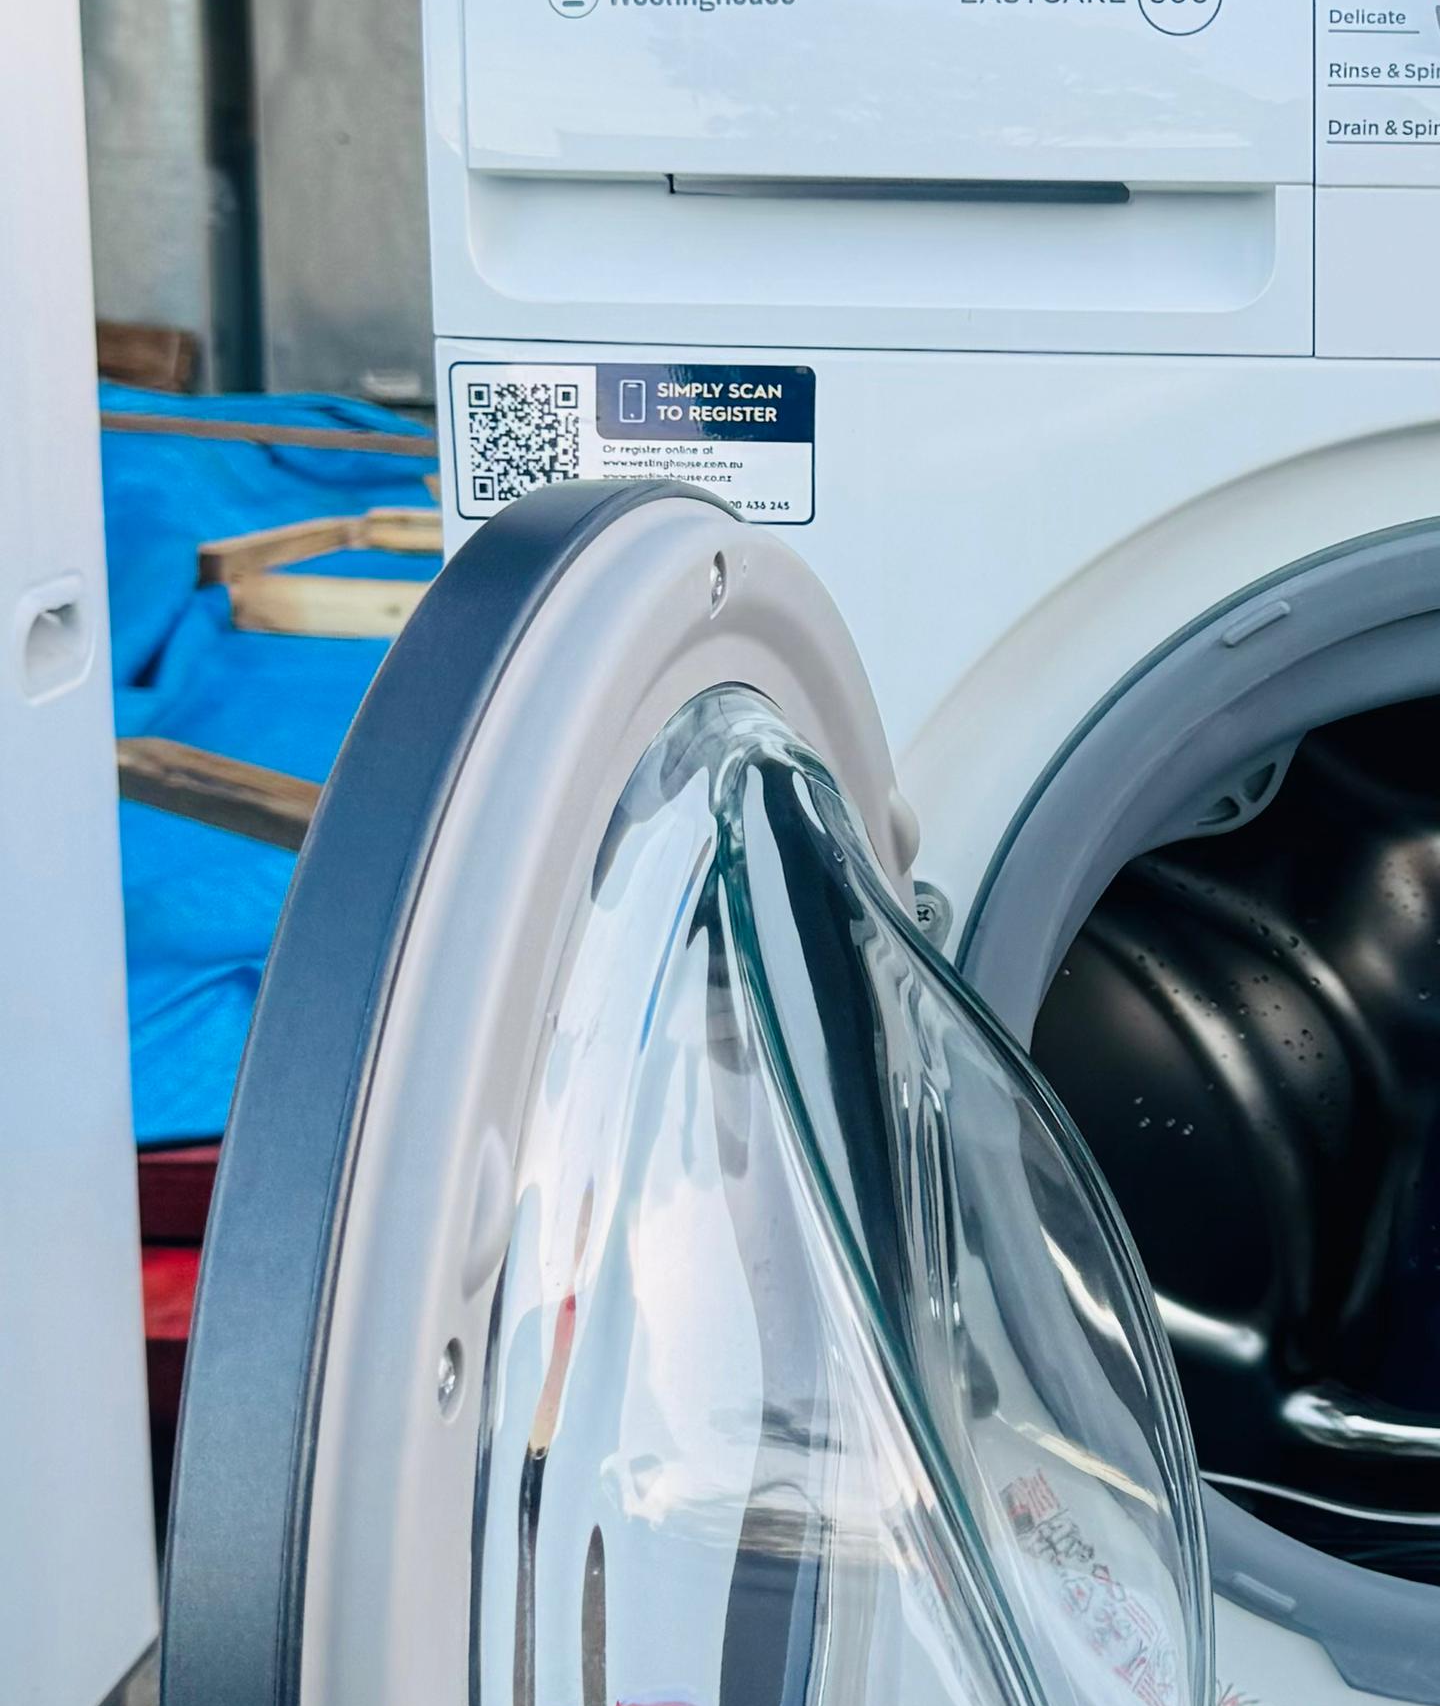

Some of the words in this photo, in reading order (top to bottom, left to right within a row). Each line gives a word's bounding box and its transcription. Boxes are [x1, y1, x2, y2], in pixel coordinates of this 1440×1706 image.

[1329, 9, 1407, 24] Delicate
[1329, 62, 1382, 79] Rinse
[1386, 63, 1400, 79] &
[1328, 119, 1379, 135] Drain
[1384, 120, 1398, 136] &
[657, 382, 724, 398] SIMPLY
[728, 383, 782, 399] SCAN
[656, 405, 683, 421] TO
[688, 405, 777, 422] REGISTER
[603, 445, 616, 453] Or
[620, 445, 662, 456] register
[665, 445, 698, 455] online
